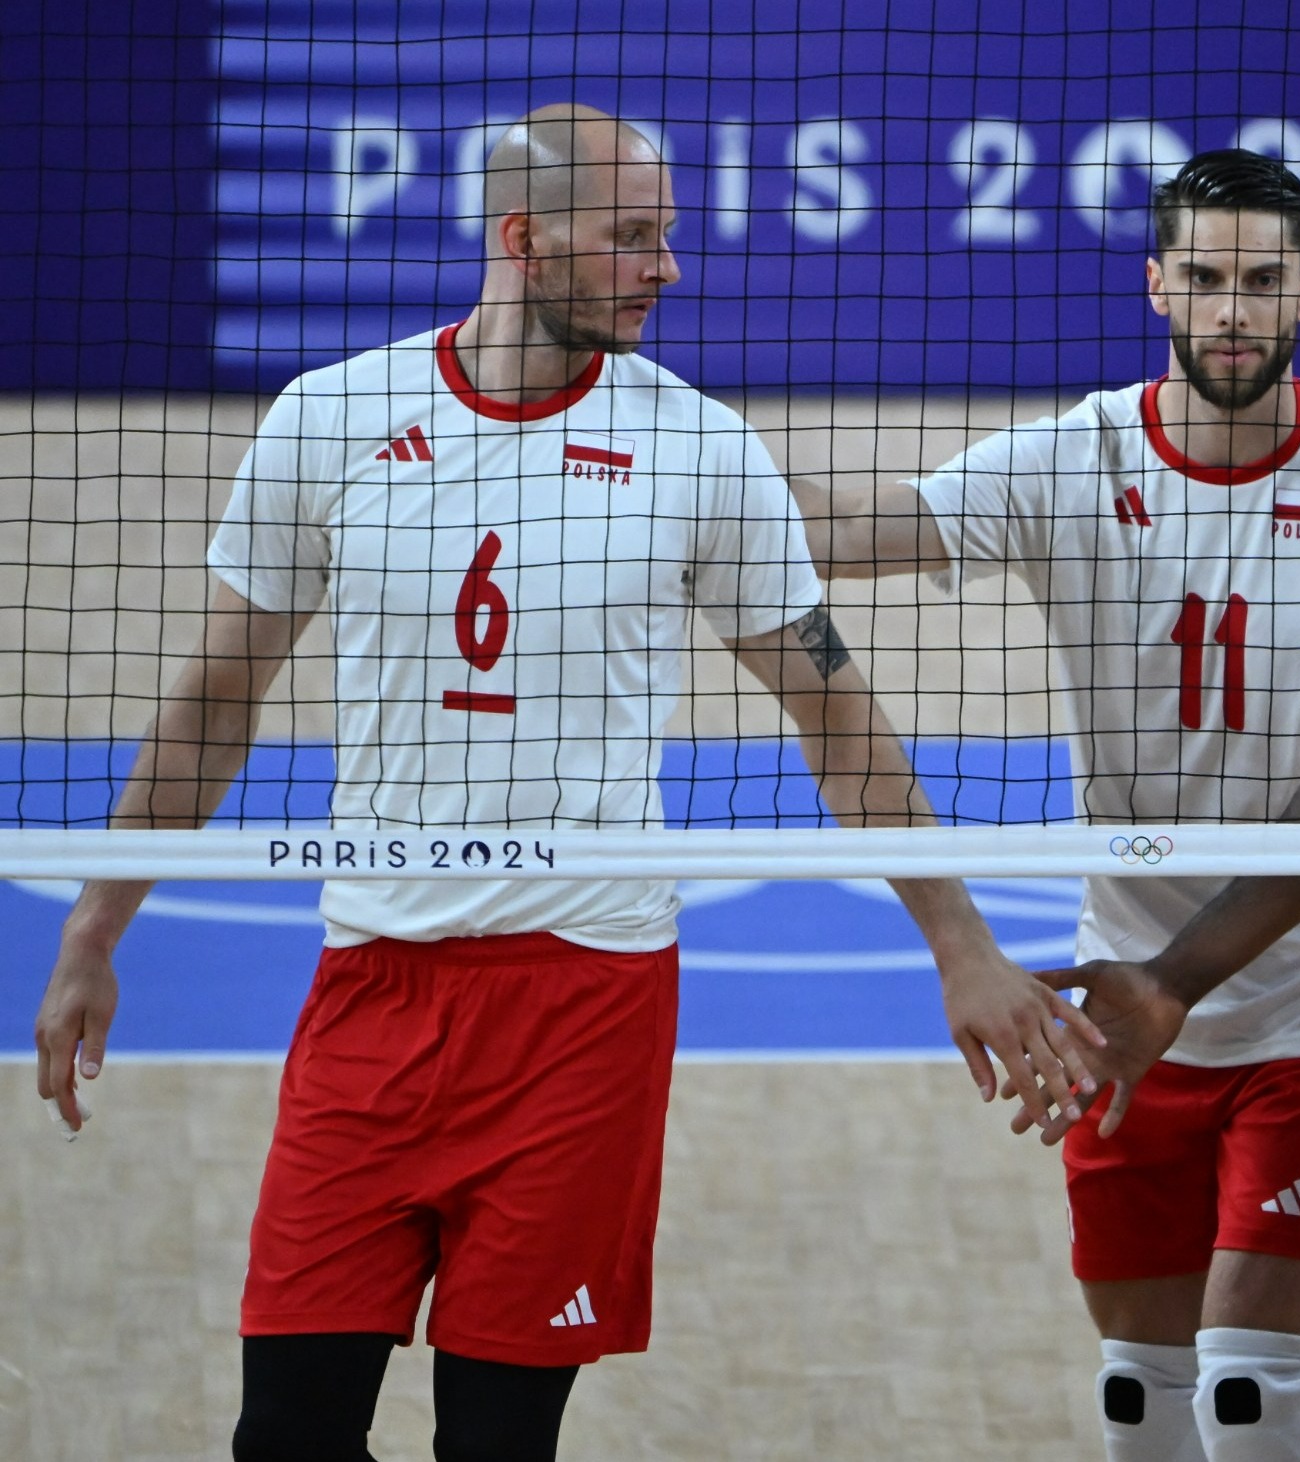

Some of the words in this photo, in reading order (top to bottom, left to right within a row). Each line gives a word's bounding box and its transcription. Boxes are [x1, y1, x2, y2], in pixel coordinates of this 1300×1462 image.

[562, 461, 630, 486] POLSKA
[455, 530, 509, 672] 6
[1170, 592, 1249, 731] 11
[430, 840, 554, 868] 2024
